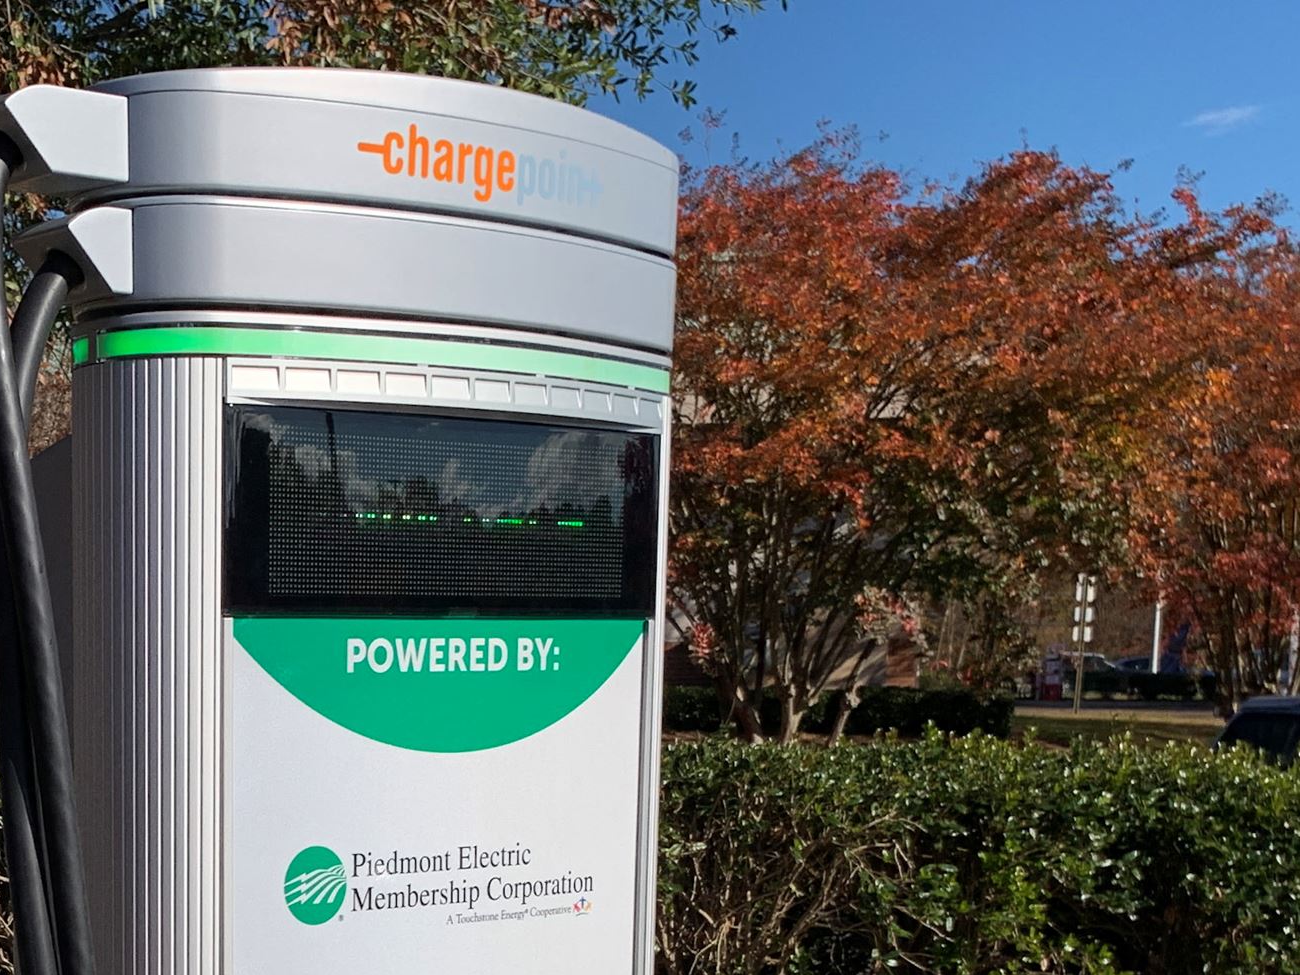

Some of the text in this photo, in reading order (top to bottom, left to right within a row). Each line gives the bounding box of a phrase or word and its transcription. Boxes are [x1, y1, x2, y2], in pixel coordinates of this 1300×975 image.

[357, 123, 604, 207] chargepoint
[347, 637, 560, 673] POWERED BY:
[352, 842, 531, 877] Piedmont Electric
[350, 870, 594, 912] Membership Corporation
[446, 914, 454, 925] A
[456, 912, 499, 924] Touchstone
[530, 906, 571, 919] Cooperative
